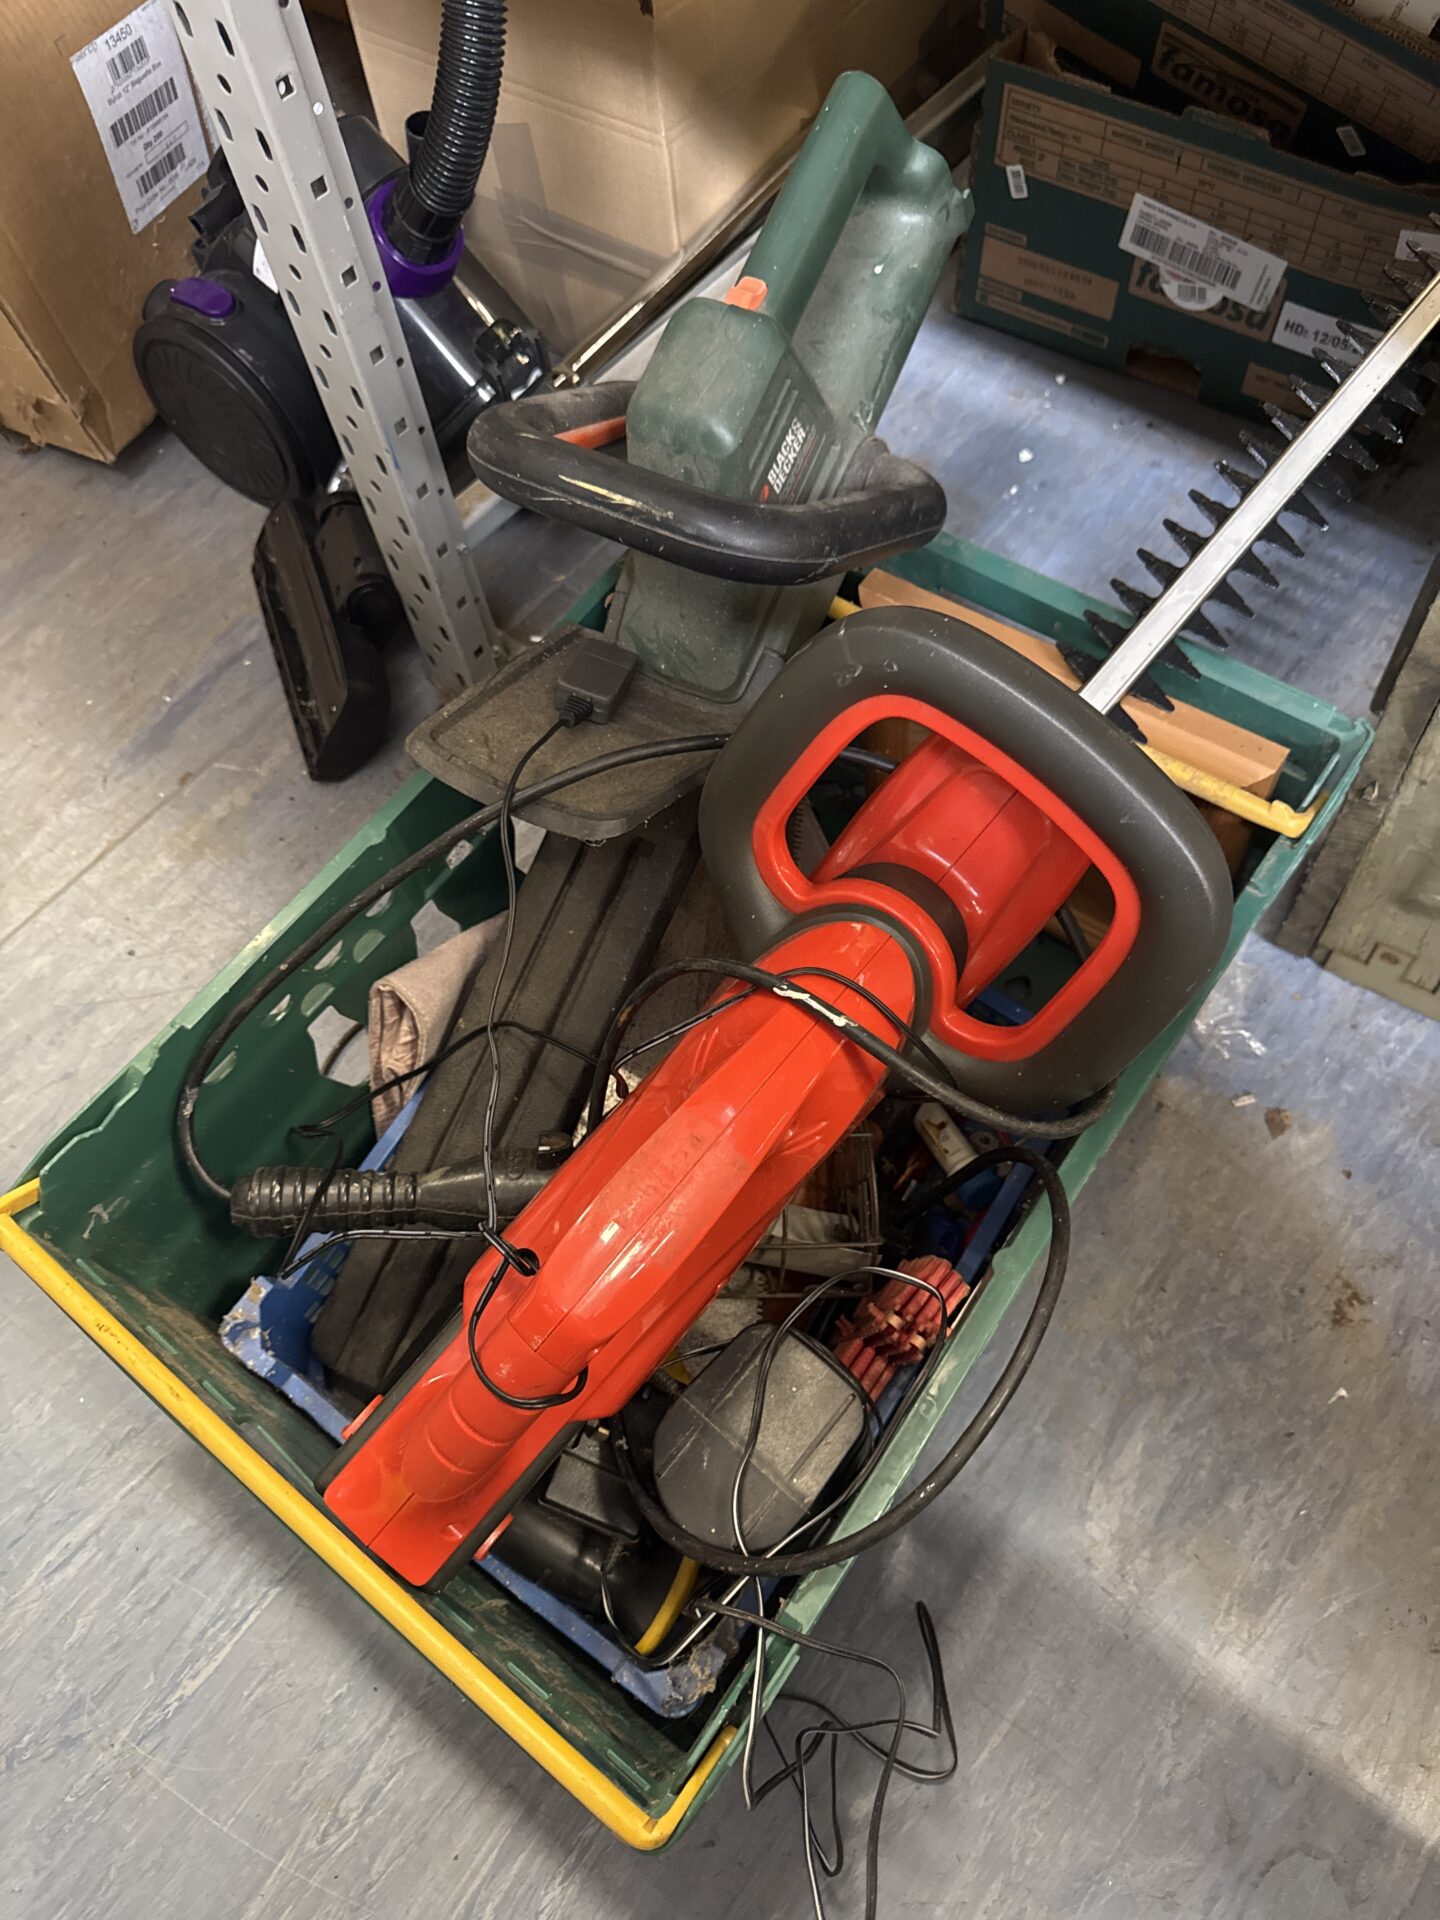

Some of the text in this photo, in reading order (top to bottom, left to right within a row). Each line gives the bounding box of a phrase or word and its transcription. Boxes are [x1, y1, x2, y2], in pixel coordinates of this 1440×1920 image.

[104, 23, 133, 51] 13450
[767, 428, 796, 486] BLACK
[773, 427, 806, 495] DECKER
